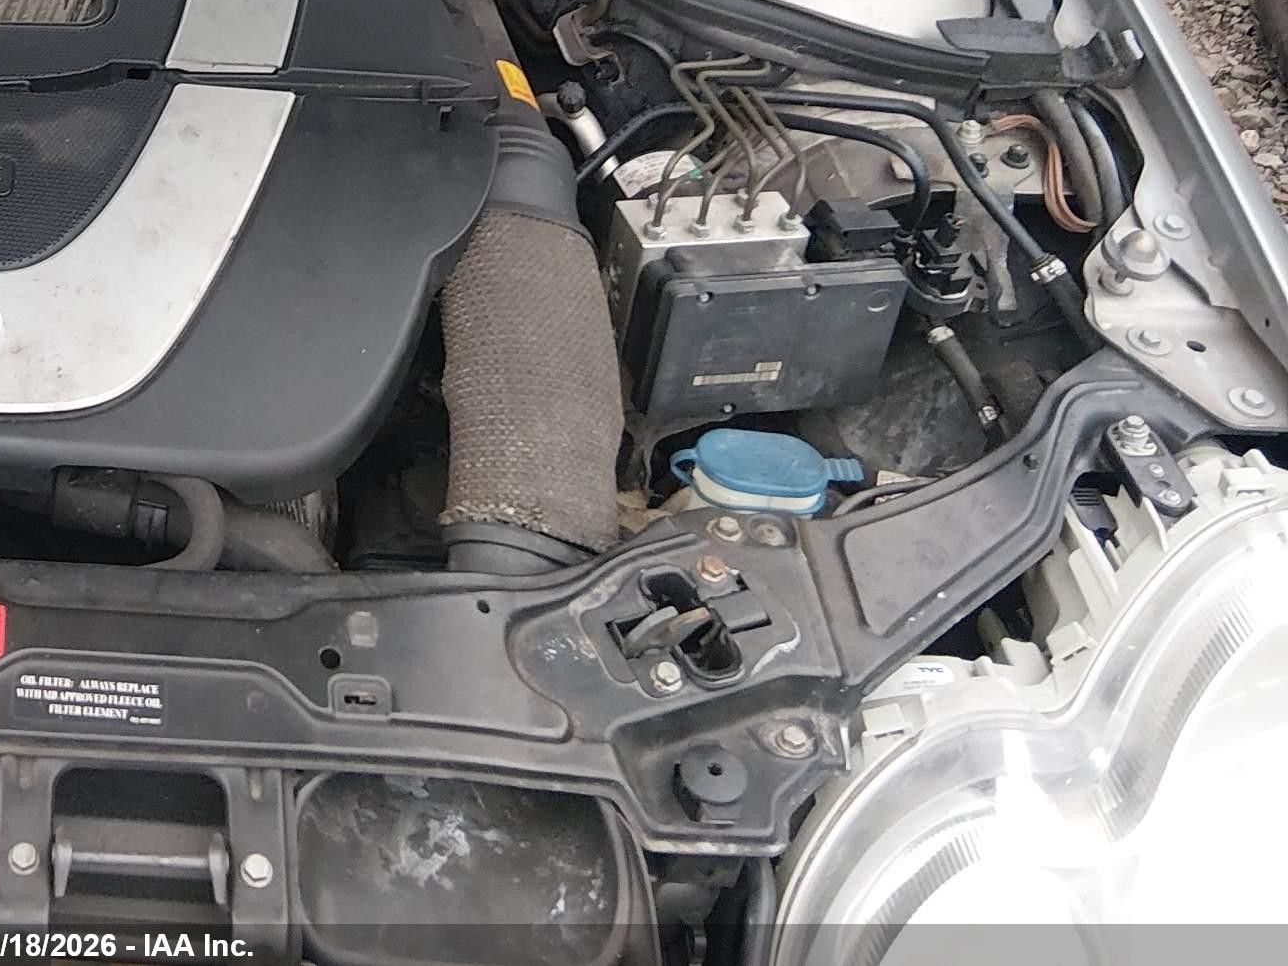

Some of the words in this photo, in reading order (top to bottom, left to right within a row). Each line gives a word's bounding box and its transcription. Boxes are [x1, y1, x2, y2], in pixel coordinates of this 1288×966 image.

[21, 675, 37, 685] OIL
[79, 680, 115, 691] ALWAYS
[116, 682, 159, 694] REPLACE
[16, 688, 41, 699] WITH
[59, 691, 107, 704] APPROVED
[108, 695, 144, 707] FLEECE
[145, 698, 162, 709] OIL
[49, 704, 81, 715] FILTER
[83, 706, 128, 719] ELEMENT
